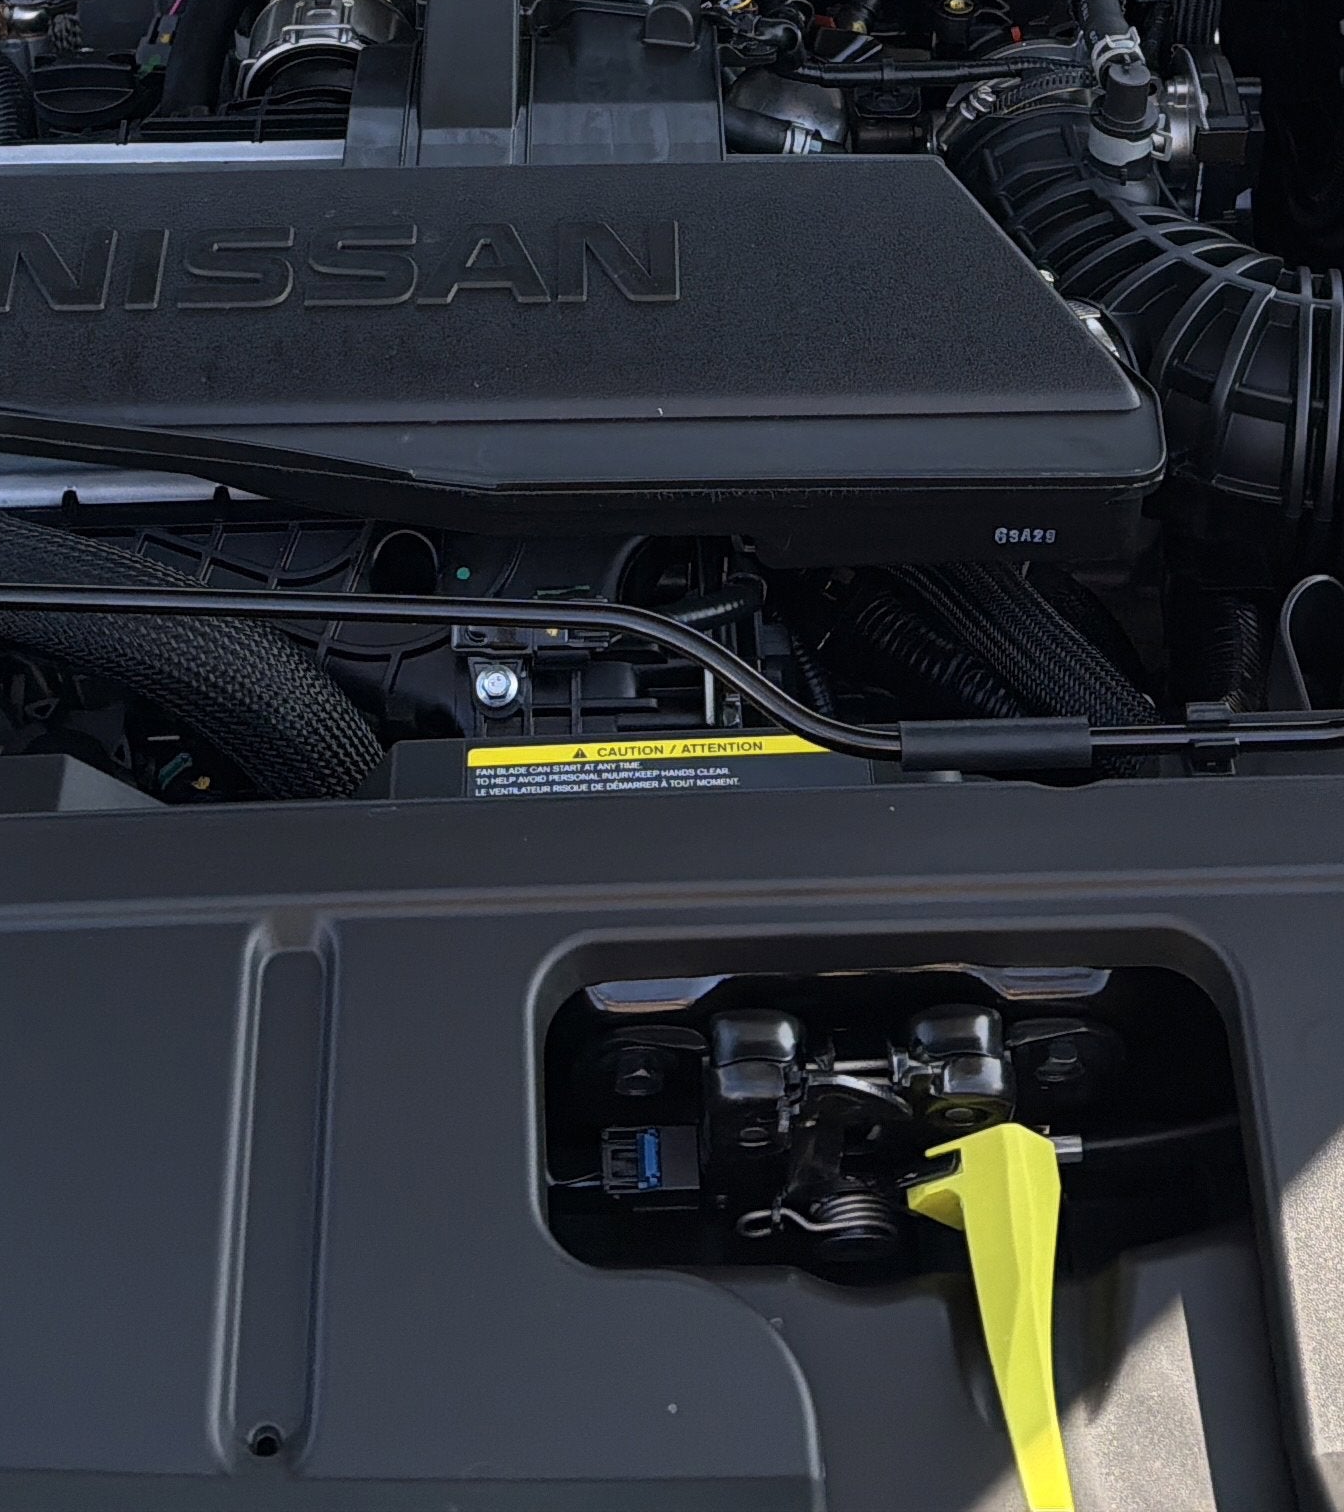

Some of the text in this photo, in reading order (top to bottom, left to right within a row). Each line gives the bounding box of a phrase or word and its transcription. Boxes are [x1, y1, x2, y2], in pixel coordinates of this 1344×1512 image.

[597, 745, 664, 758] CAUTION
[681, 741, 763, 754] ATTENTION
[475, 768, 495, 776] FAN
[497, 767, 527, 775] BLADE
[529, 766, 550, 774] CAN
[552, 764, 581, 773] START
[584, 763, 595, 771] AT
[596, 762, 616, 771] ANY
[476, 778, 489, 786] TO
[491, 777, 515, 785] HELP
[517, 775, 547, 784] AVOID
[548, 773, 599, 782] PERSONAL
[661, 768, 695, 777] HANDS
[475, 788, 489, 797] LE
[489, 786, 551, 796] VENTILATEUR
[552, 783, 589, 793] RISQUE
[591, 782, 604, 791] DE
[606, 778, 659, 791] DÉMARRER
[660, 778, 668, 787] À
[670, 778, 695, 787] TOUT
